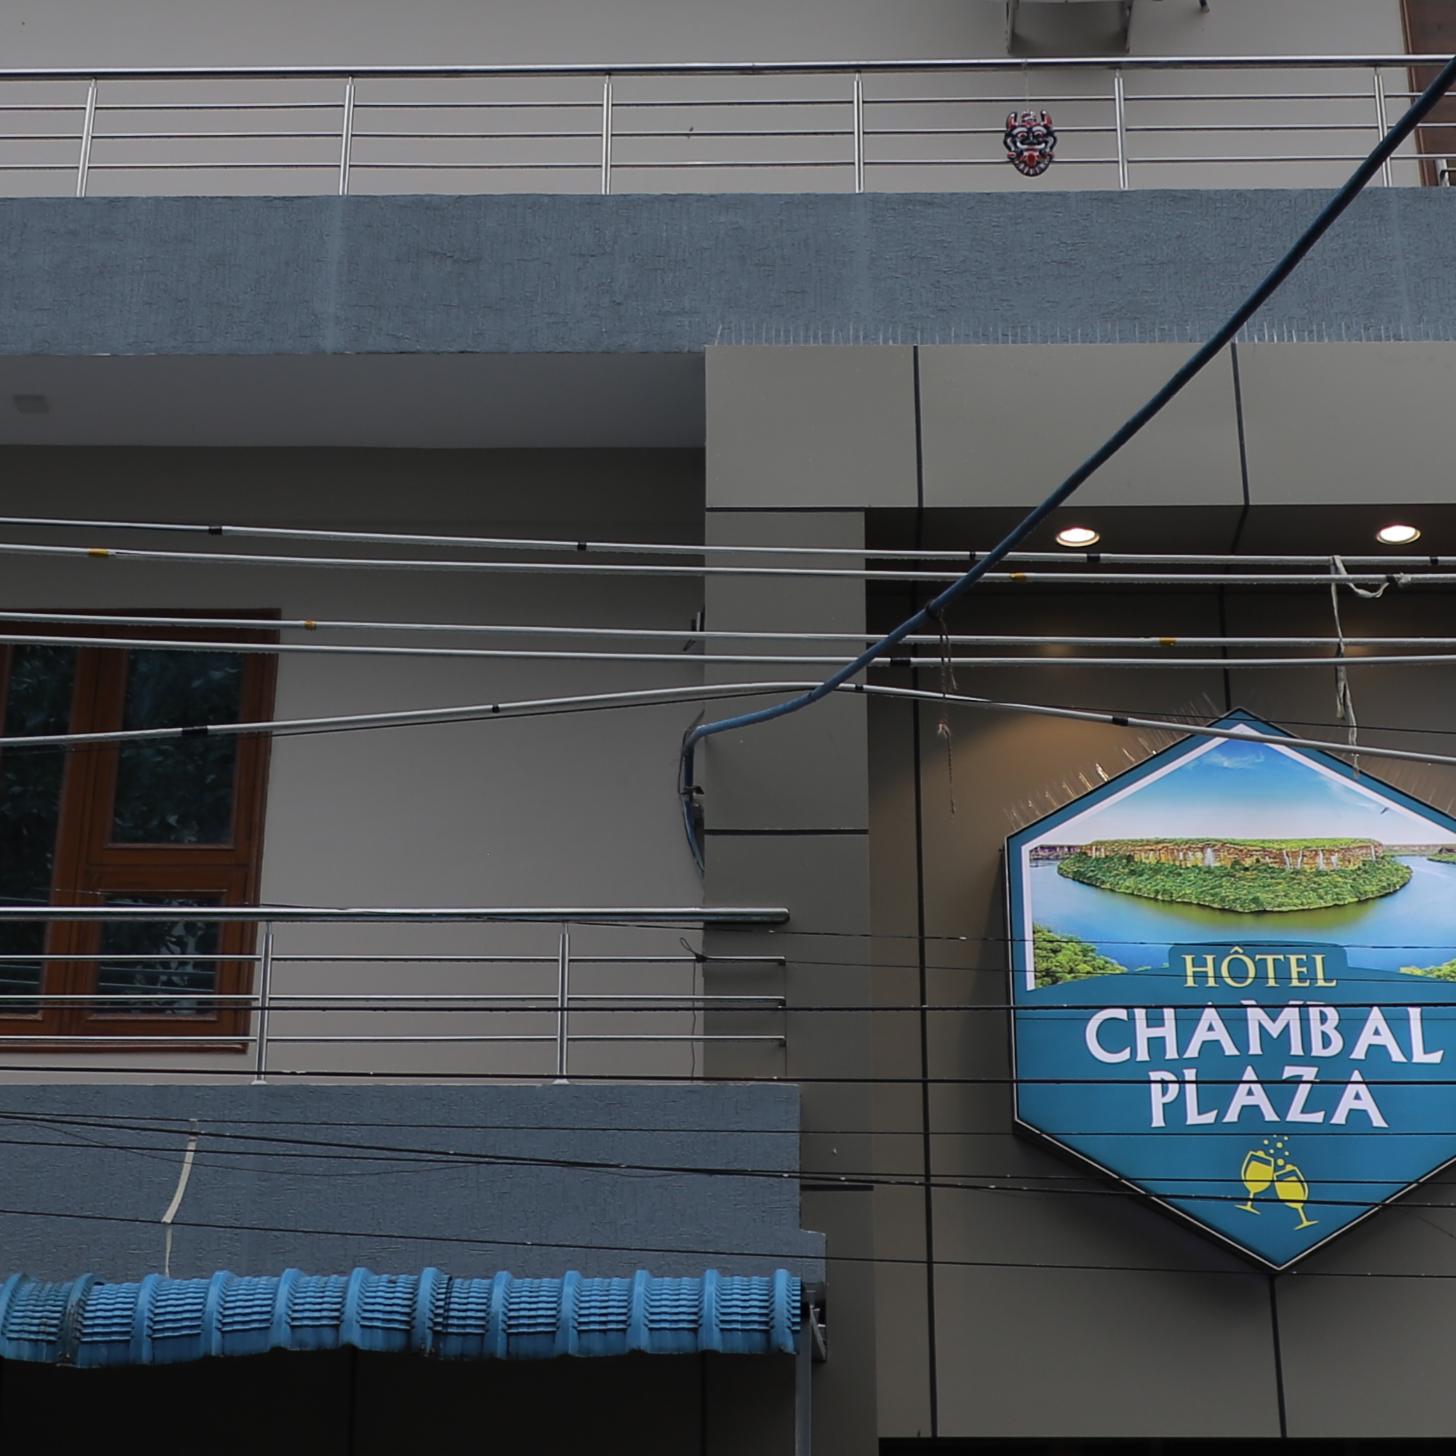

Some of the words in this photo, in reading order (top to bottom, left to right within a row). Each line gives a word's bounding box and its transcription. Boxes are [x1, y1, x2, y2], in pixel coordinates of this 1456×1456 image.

[1181, 945, 1337, 988] HÔTEL
[1084, 999, 1445, 1064] CHAMBAL
[1147, 1065, 1390, 1129] PLAZA
